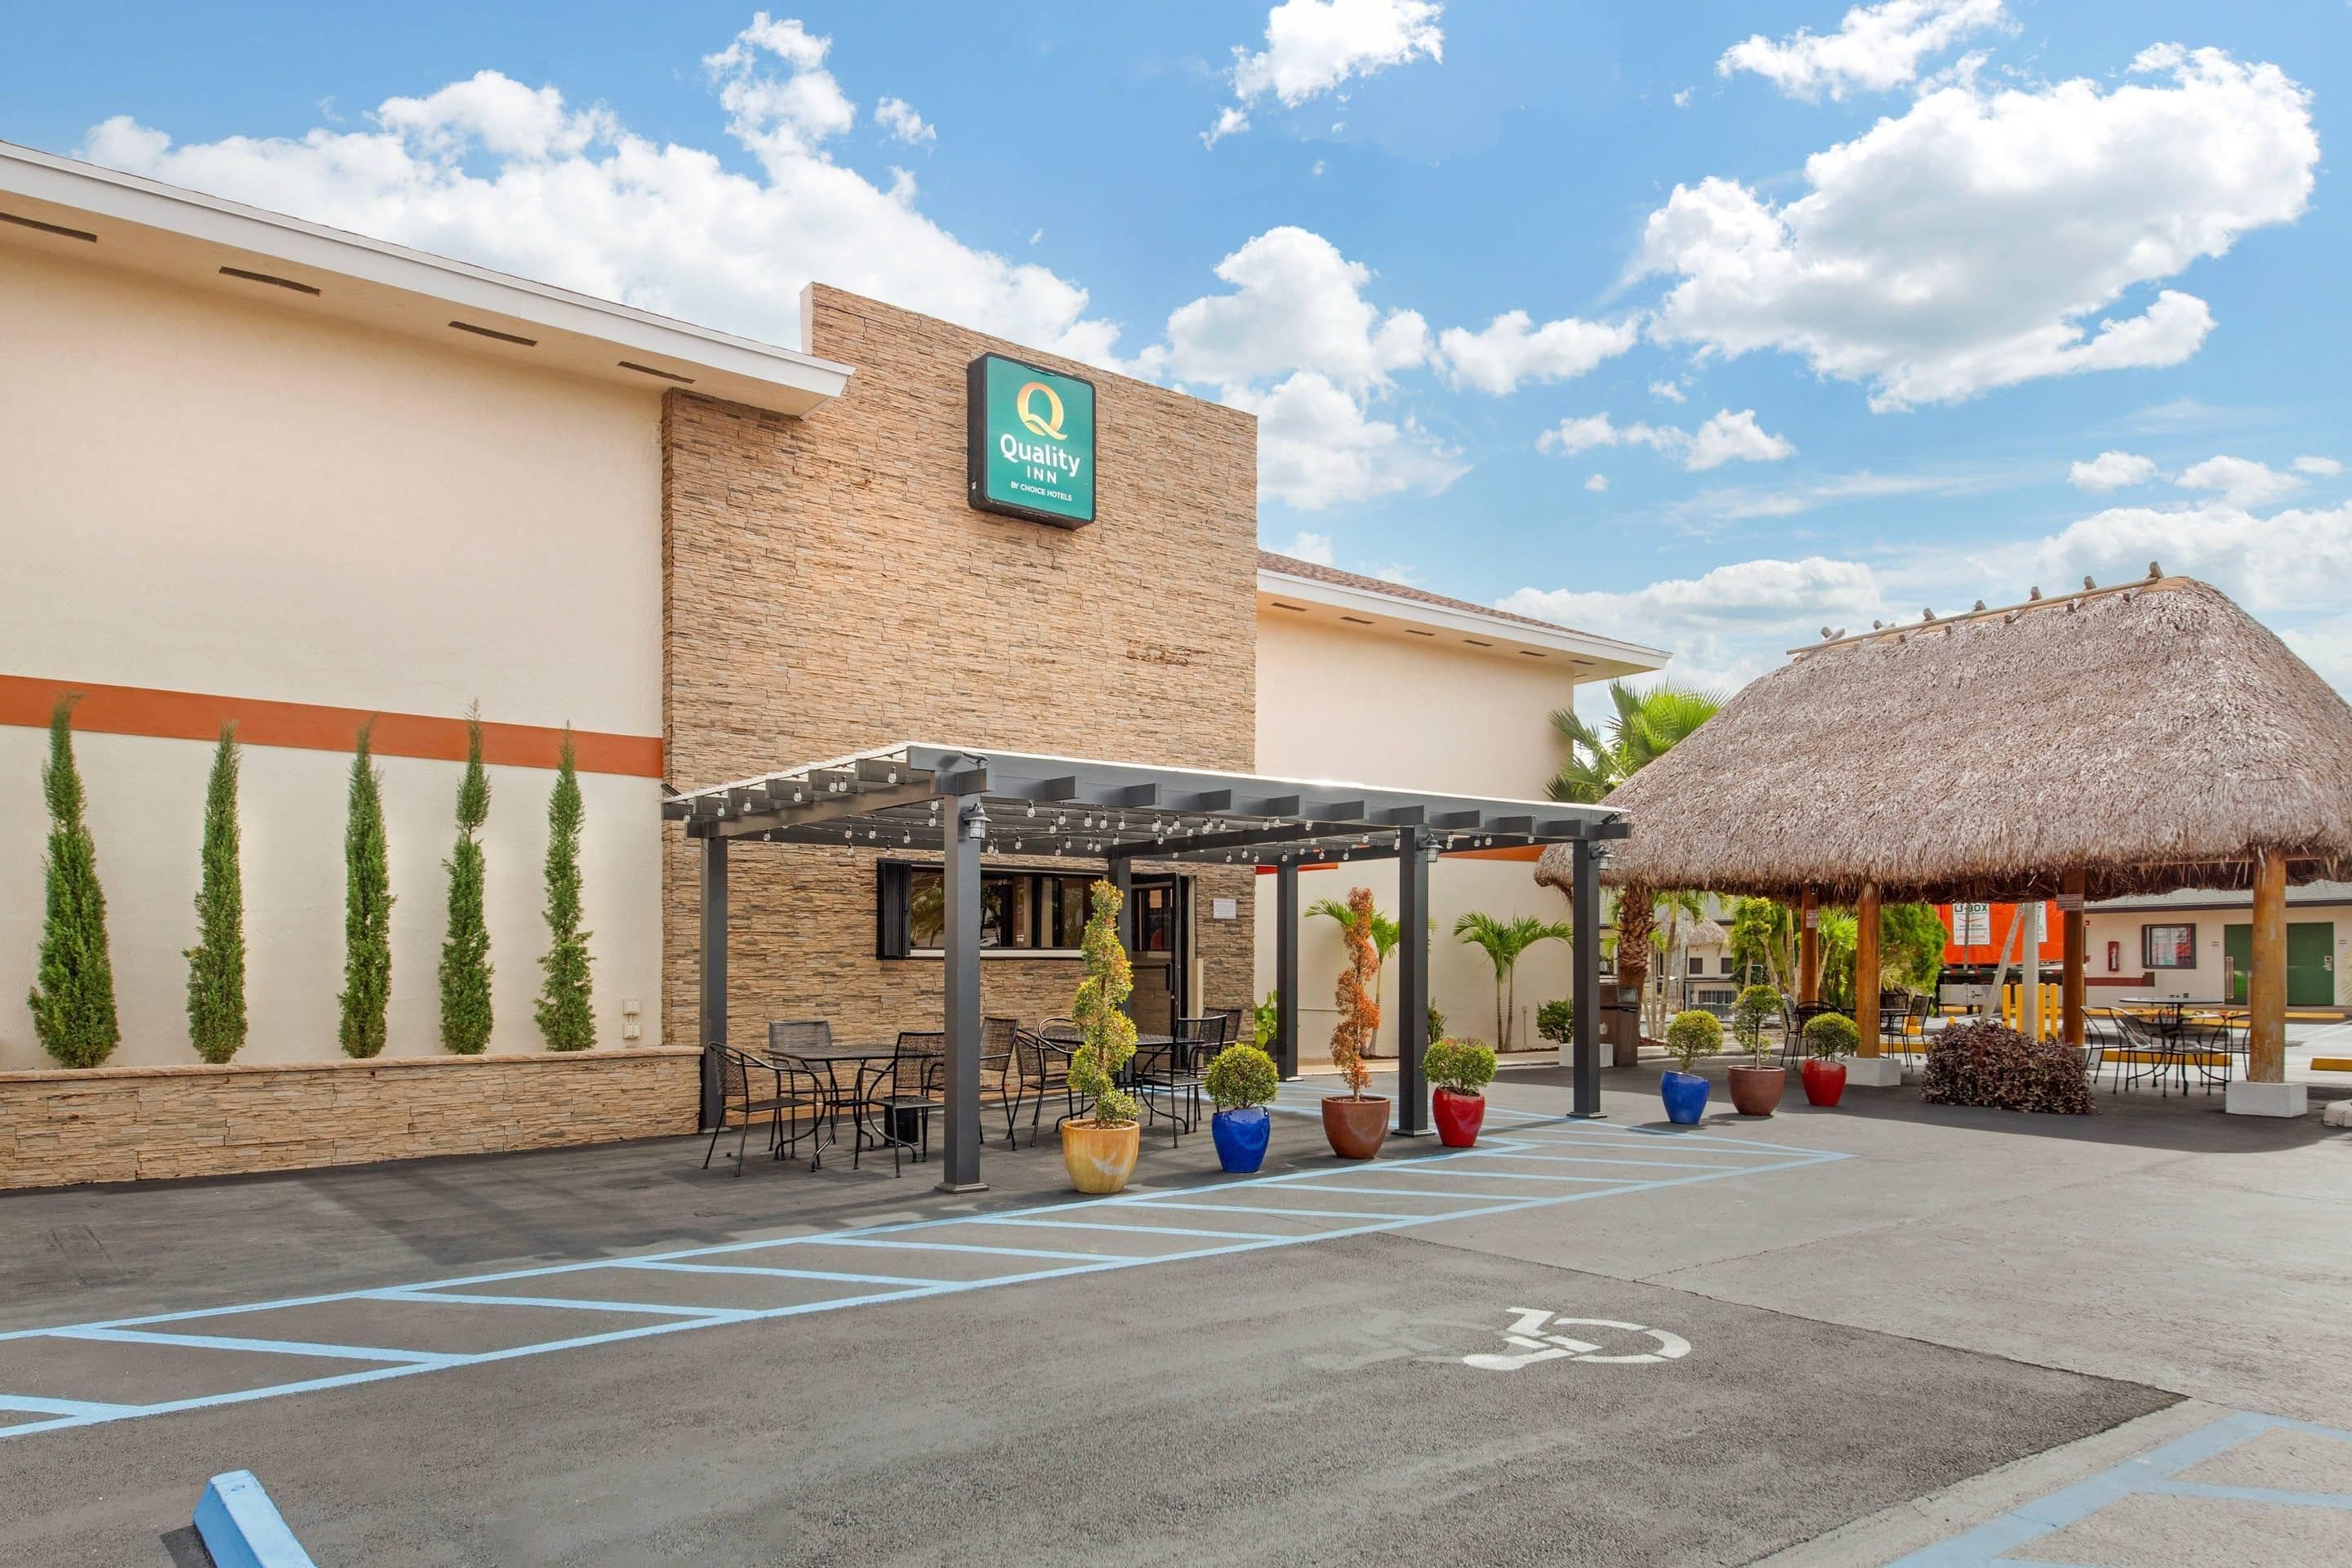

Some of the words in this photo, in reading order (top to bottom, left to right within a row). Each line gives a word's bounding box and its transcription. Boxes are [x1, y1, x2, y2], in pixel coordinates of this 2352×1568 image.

[1018, 381, 1067, 440] Q
[1000, 434, 1080, 478] Quality
[1010, 481, 1019, 489] BY
[1020, 483, 1046, 496] CHOICE
[1047, 489, 1072, 501] HOTELS
[1027, 466, 1057, 484] INN
